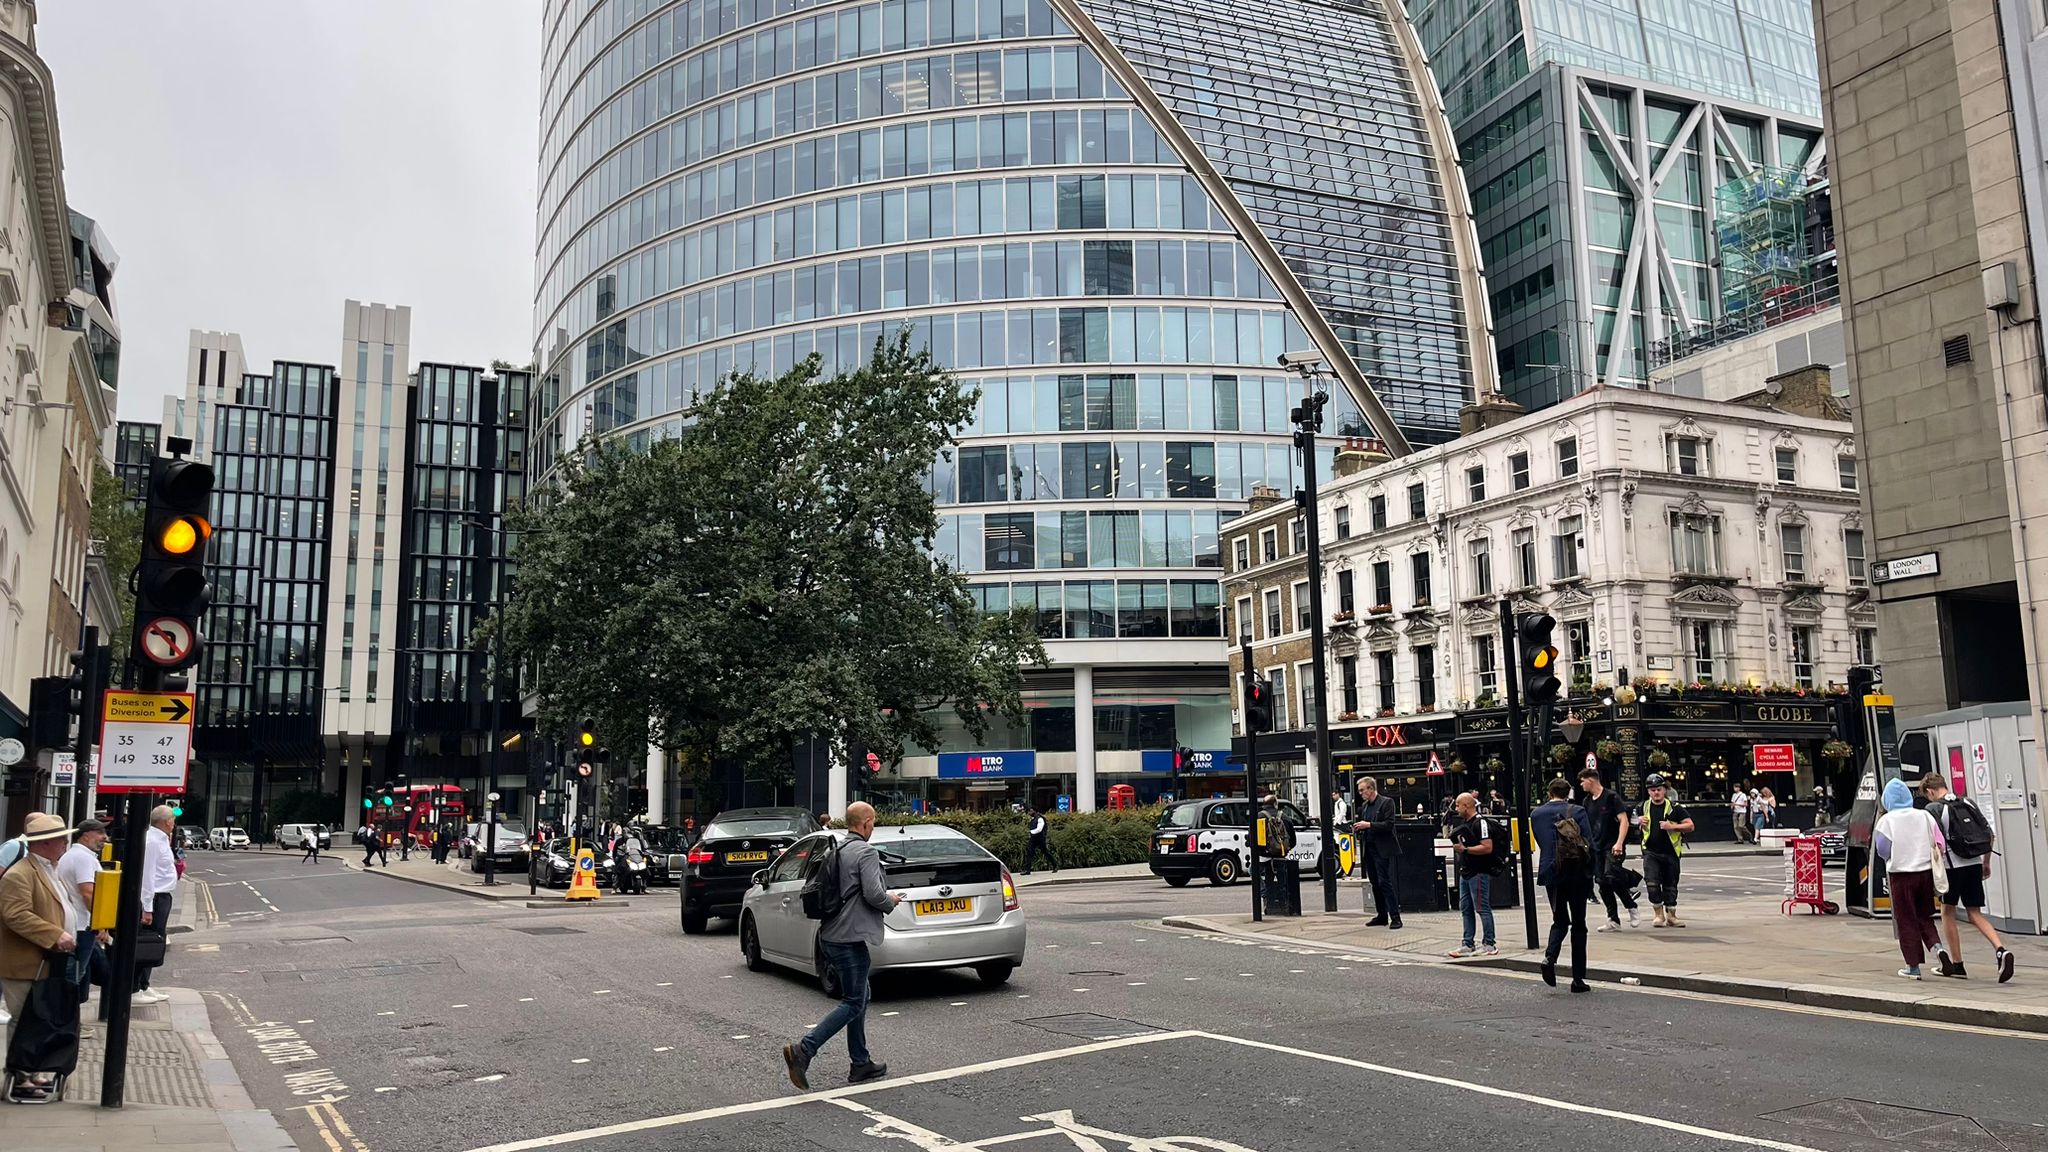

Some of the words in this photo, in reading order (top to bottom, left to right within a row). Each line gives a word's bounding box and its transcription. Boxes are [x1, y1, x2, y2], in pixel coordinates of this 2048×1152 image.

[1892, 559, 1922, 569] LONDON
[1893, 568, 1912, 576] WALL
[111, 698, 139, 707] Buses
[110, 708, 156, 717] Diversion
[1618, 707, 1635, 716] 199
[1757, 706, 1812, 721] GLOBE
[118, 735, 134, 746] 35
[157, 736, 173, 746] 47
[1366, 725, 1407, 747] FOX
[113, 754, 135, 764] 149
[151, 754, 175, 765] 388
[967, 756, 1004, 773] METRO
[731, 852, 747, 860] SK14
[748, 851, 764, 860] RYG
[1799, 883, 1818, 892] FREE
[922, 901, 945, 914] LA13
[947, 898, 967, 911] JXU
